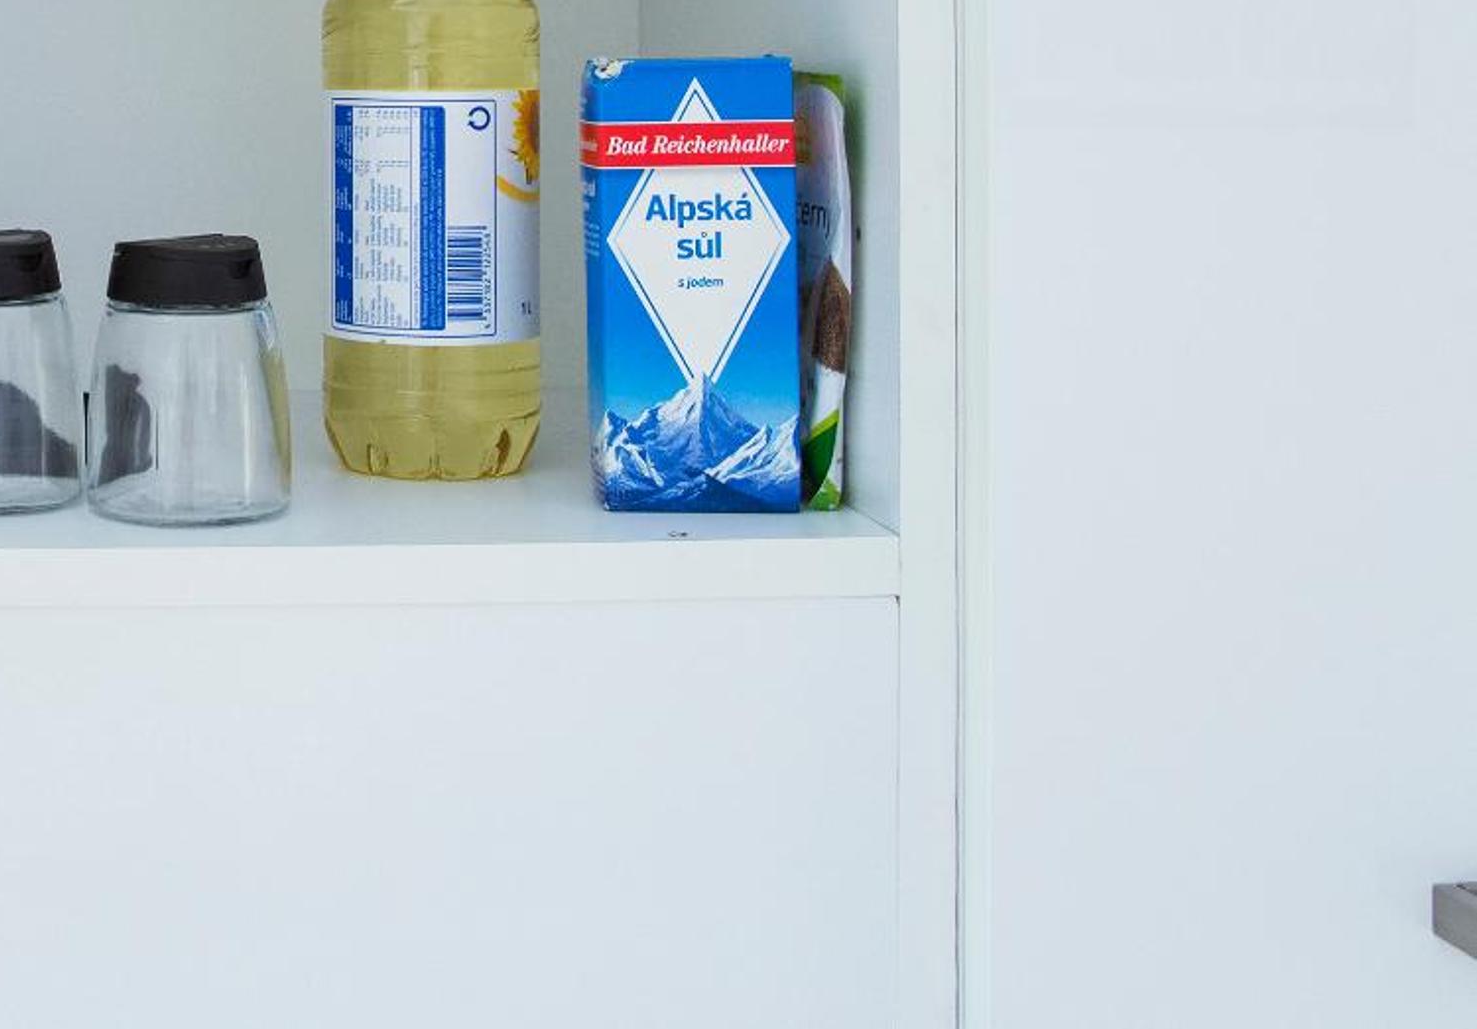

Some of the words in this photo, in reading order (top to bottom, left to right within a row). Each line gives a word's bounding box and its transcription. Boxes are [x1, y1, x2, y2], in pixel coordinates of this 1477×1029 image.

[606, 135, 647, 156] Bad
[651, 133, 790, 155] Reichenhaller
[645, 192, 752, 228] Alpská
[677, 231, 722, 260] sůl
[678, 278, 685, 288] s
[686, 276, 724, 289] jodem
